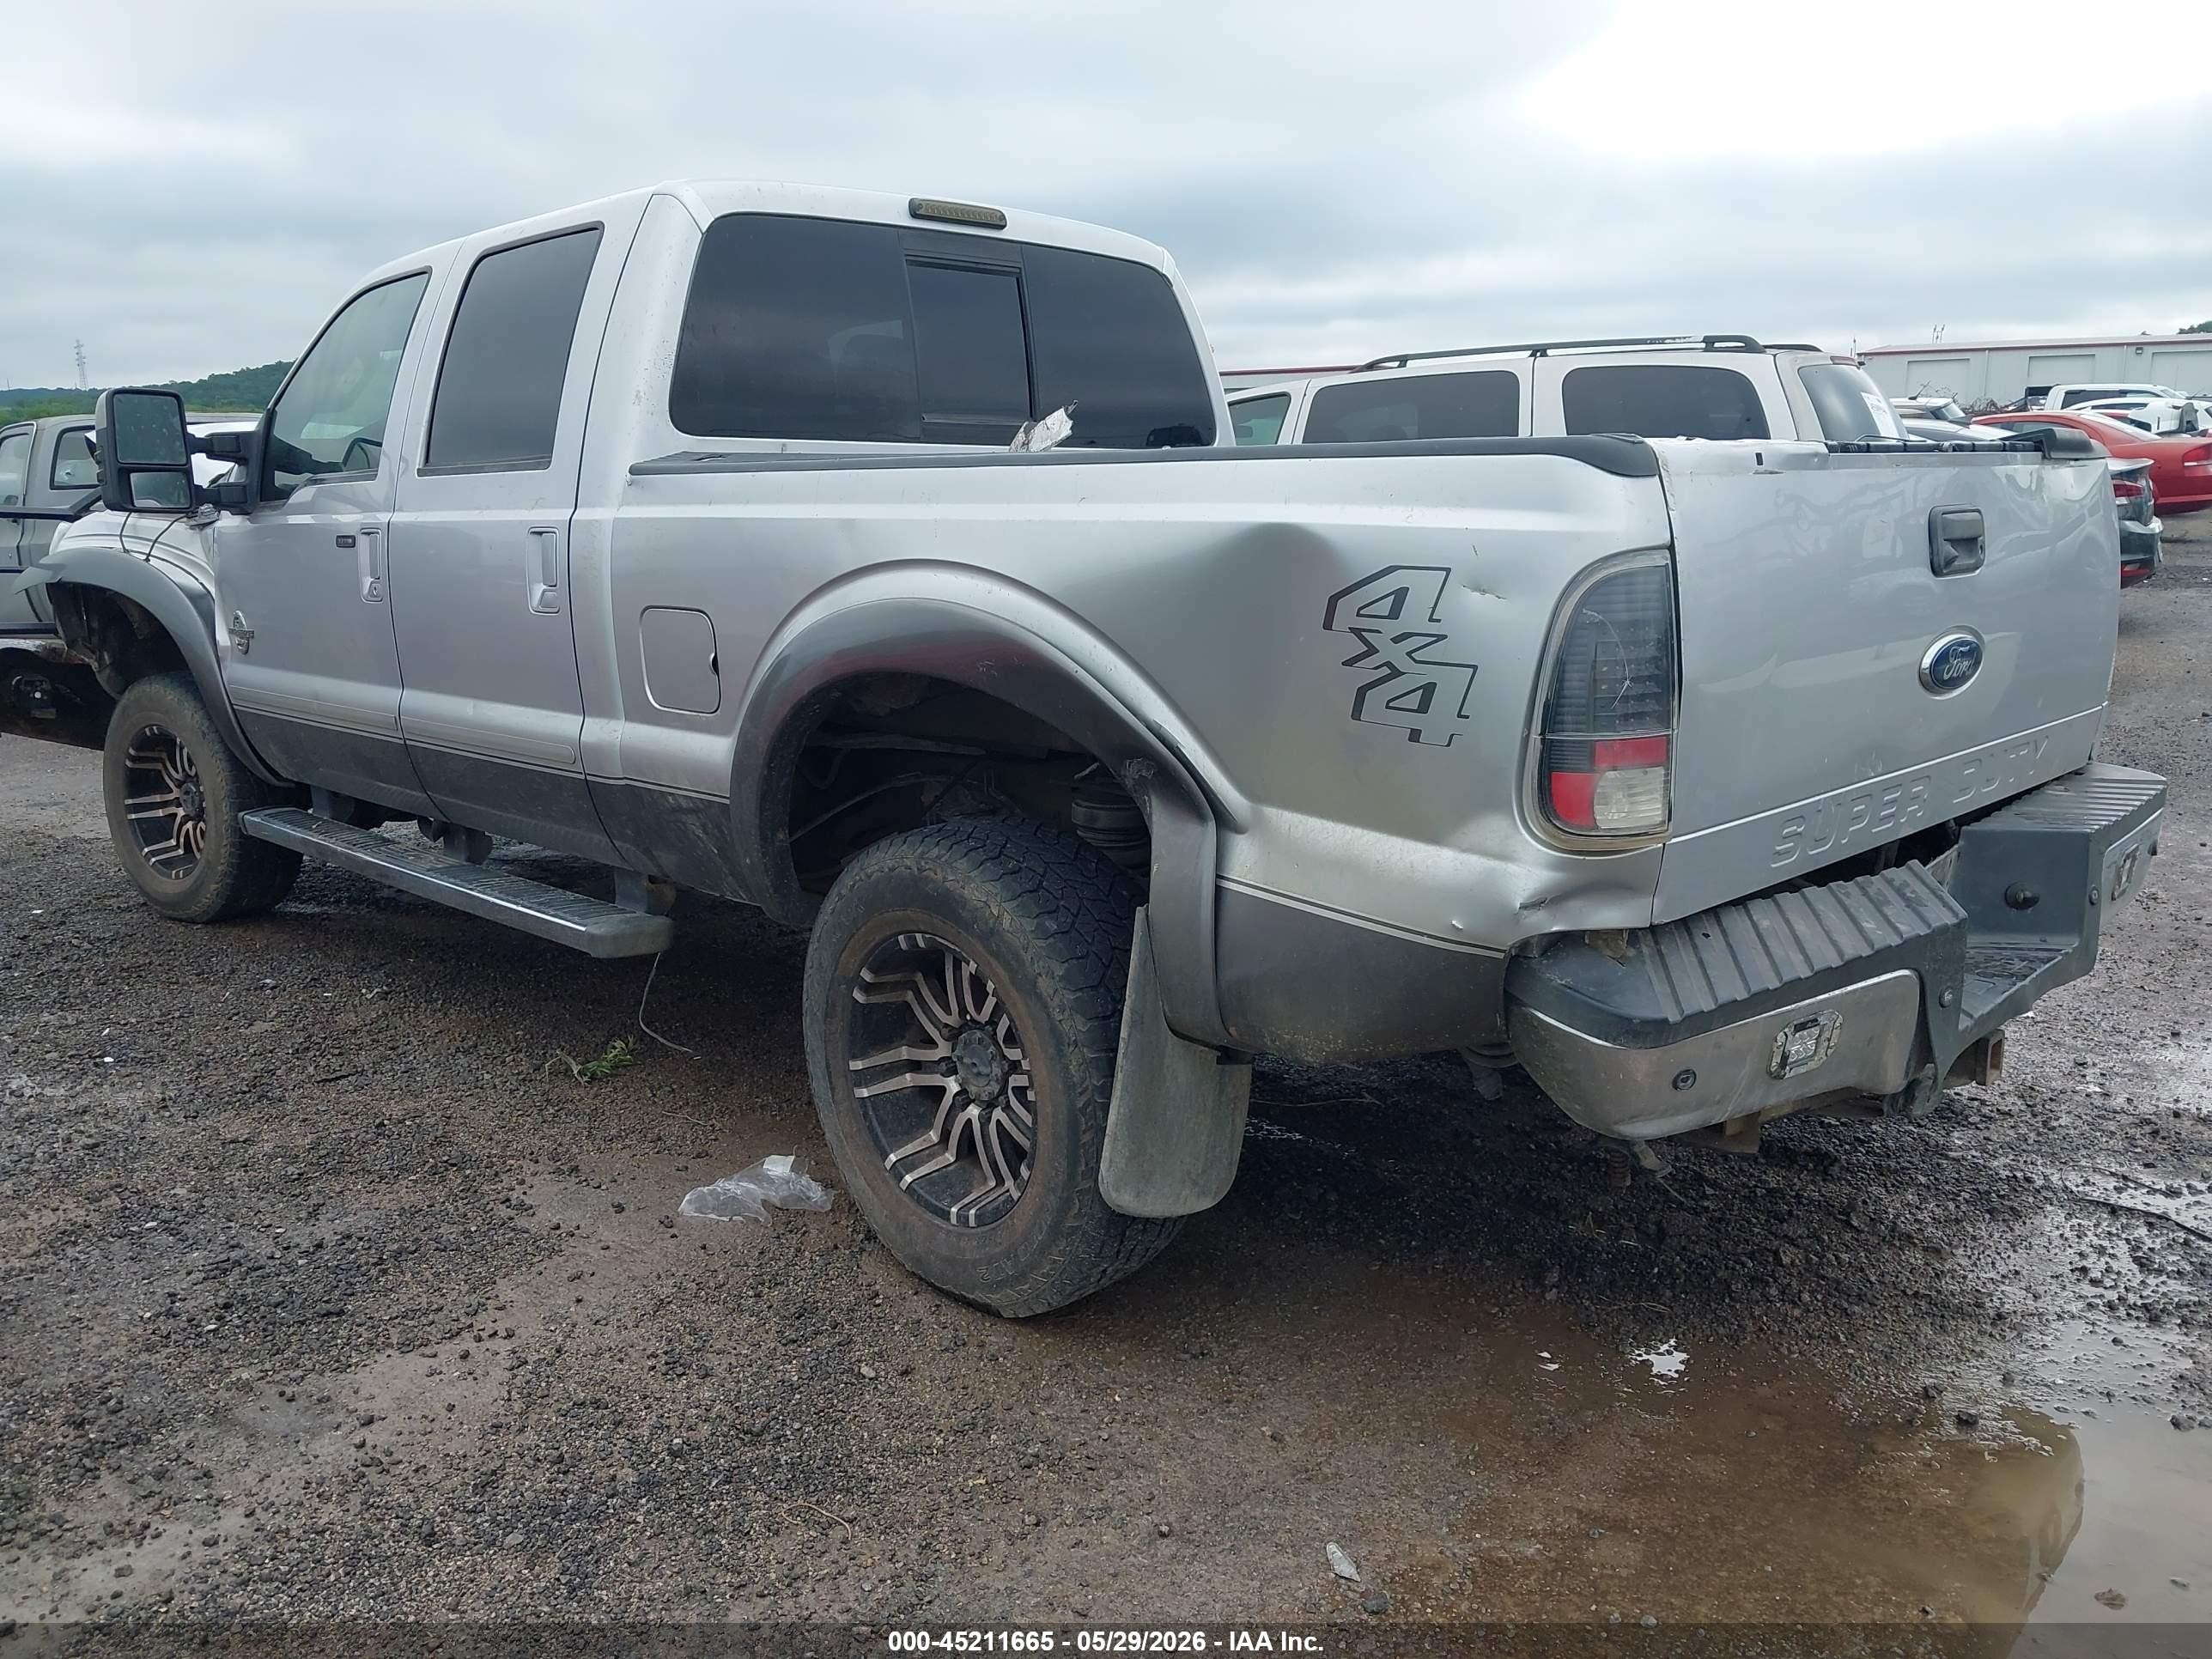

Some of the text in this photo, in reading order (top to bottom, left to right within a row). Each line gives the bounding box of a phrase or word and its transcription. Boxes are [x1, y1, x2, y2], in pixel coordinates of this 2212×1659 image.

[1942, 645, 1978, 681] Ford
[1770, 735, 2049, 868] SUPER DUTY
